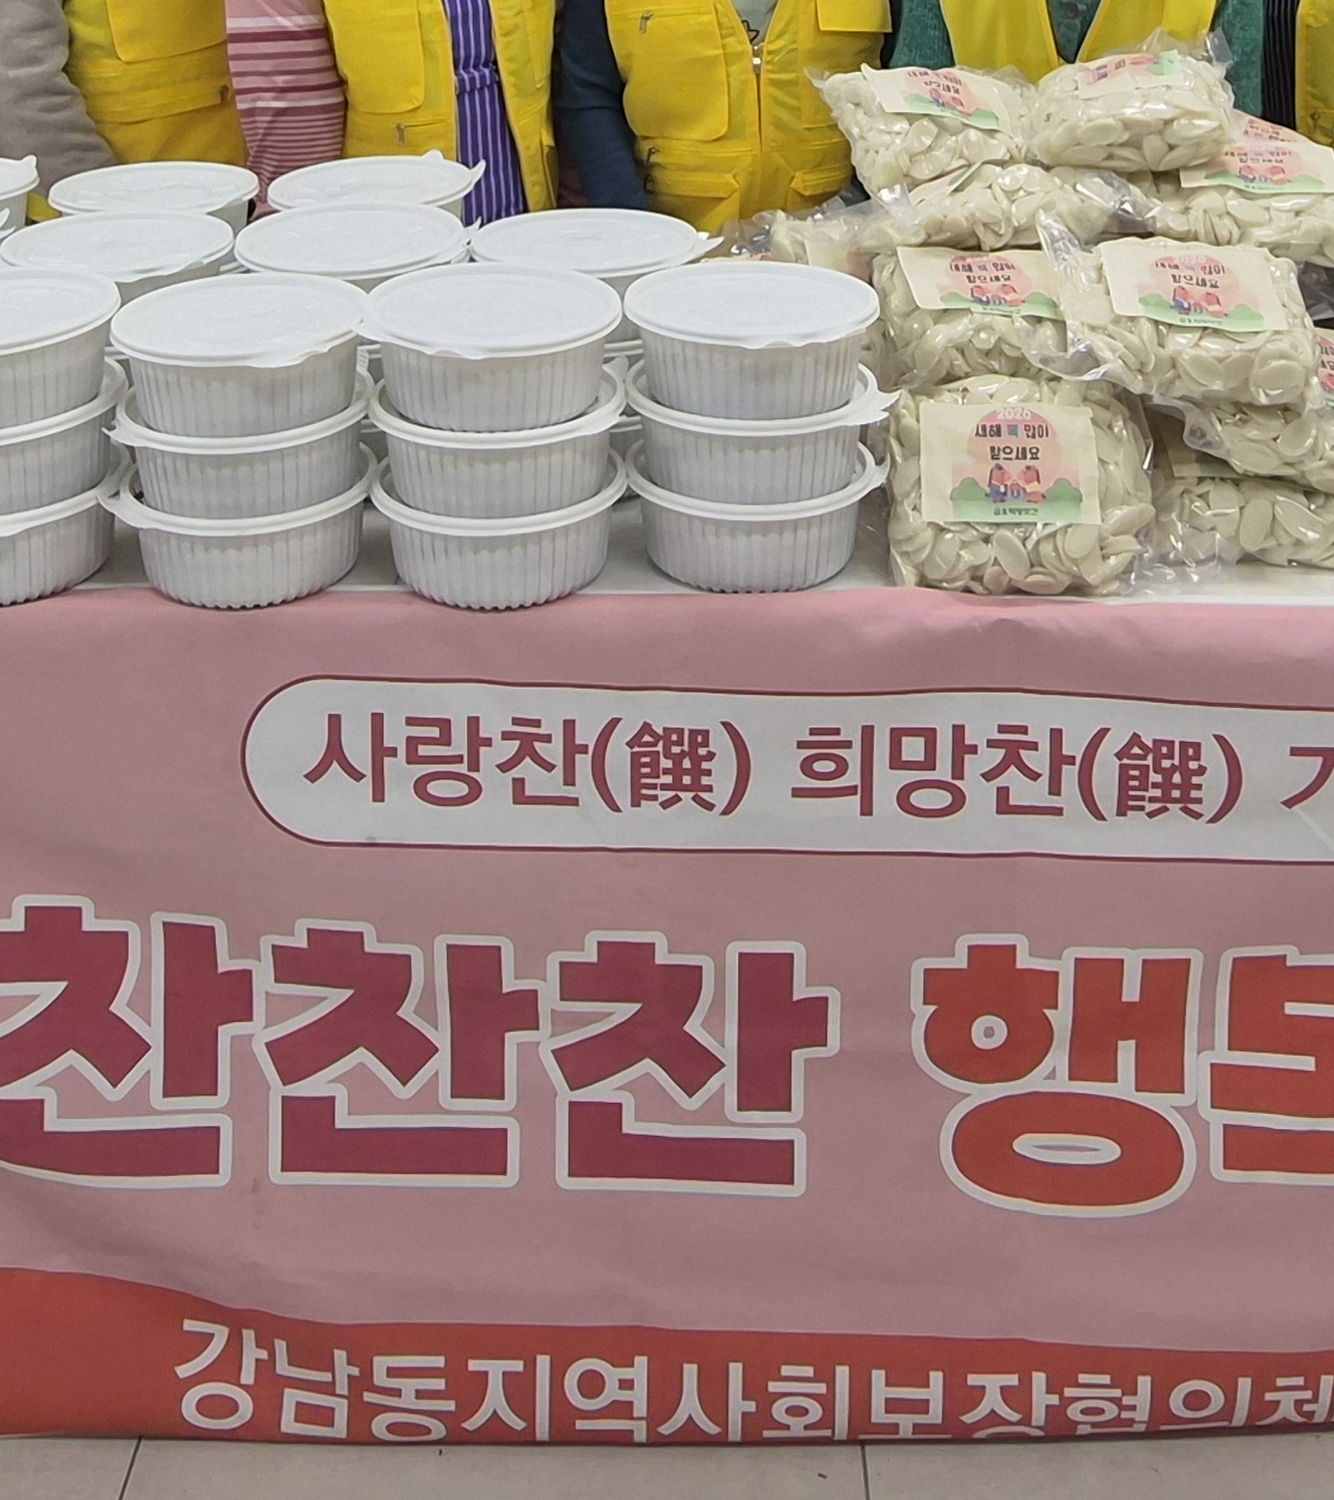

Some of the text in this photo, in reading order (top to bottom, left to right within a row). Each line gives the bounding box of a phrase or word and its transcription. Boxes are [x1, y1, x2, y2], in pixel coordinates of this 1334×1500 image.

[996, 407, 1032, 420] 2026
[974, 423, 1002, 438] 새해
[1023, 423, 1049, 439] 많이
[989, 445, 1041, 461] 받으세요
[302, 711, 753, 817] 사랑찬(饌)
[789, 722, 1244, 826] 희망찬(饌)
